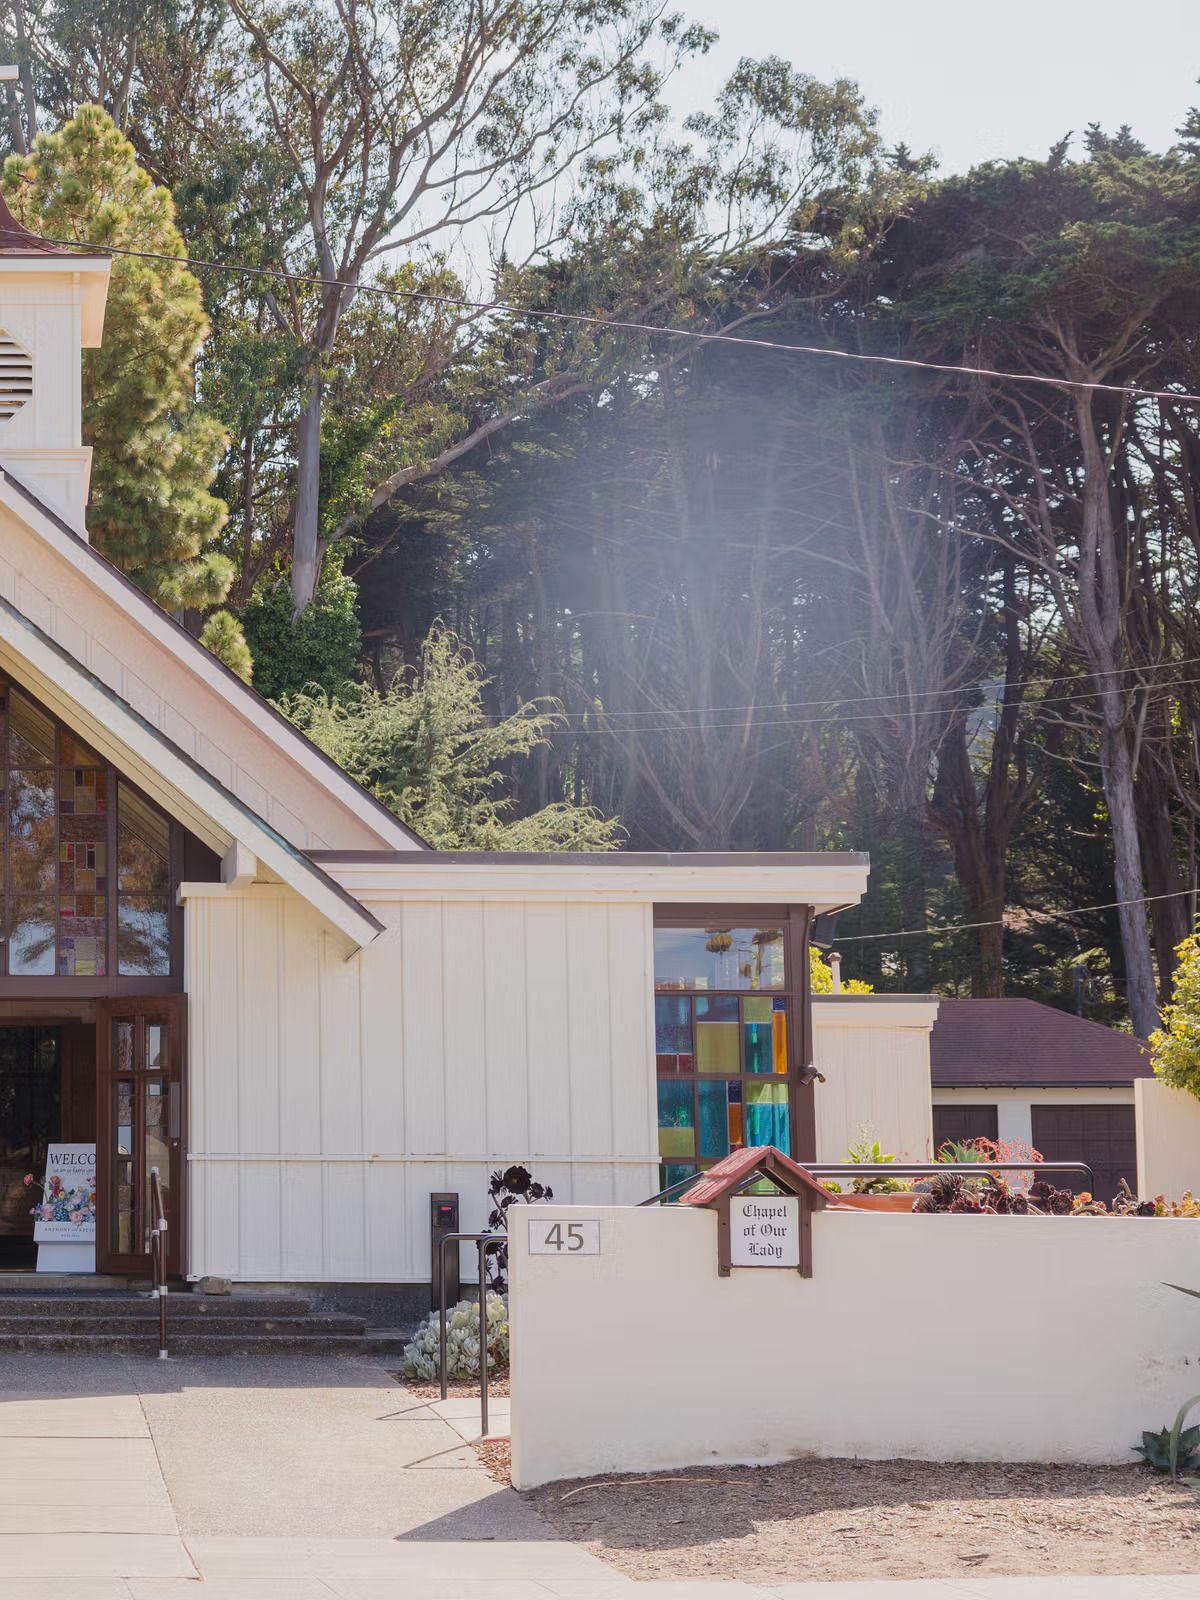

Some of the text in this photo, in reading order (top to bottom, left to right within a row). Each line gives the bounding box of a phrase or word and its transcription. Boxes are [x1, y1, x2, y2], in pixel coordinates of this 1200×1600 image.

[742, 1204, 787, 1220] Chapel
[544, 1223, 584, 1251] 45
[743, 1223, 787, 1237] of Our
[748, 1242, 783, 1259] Lady
